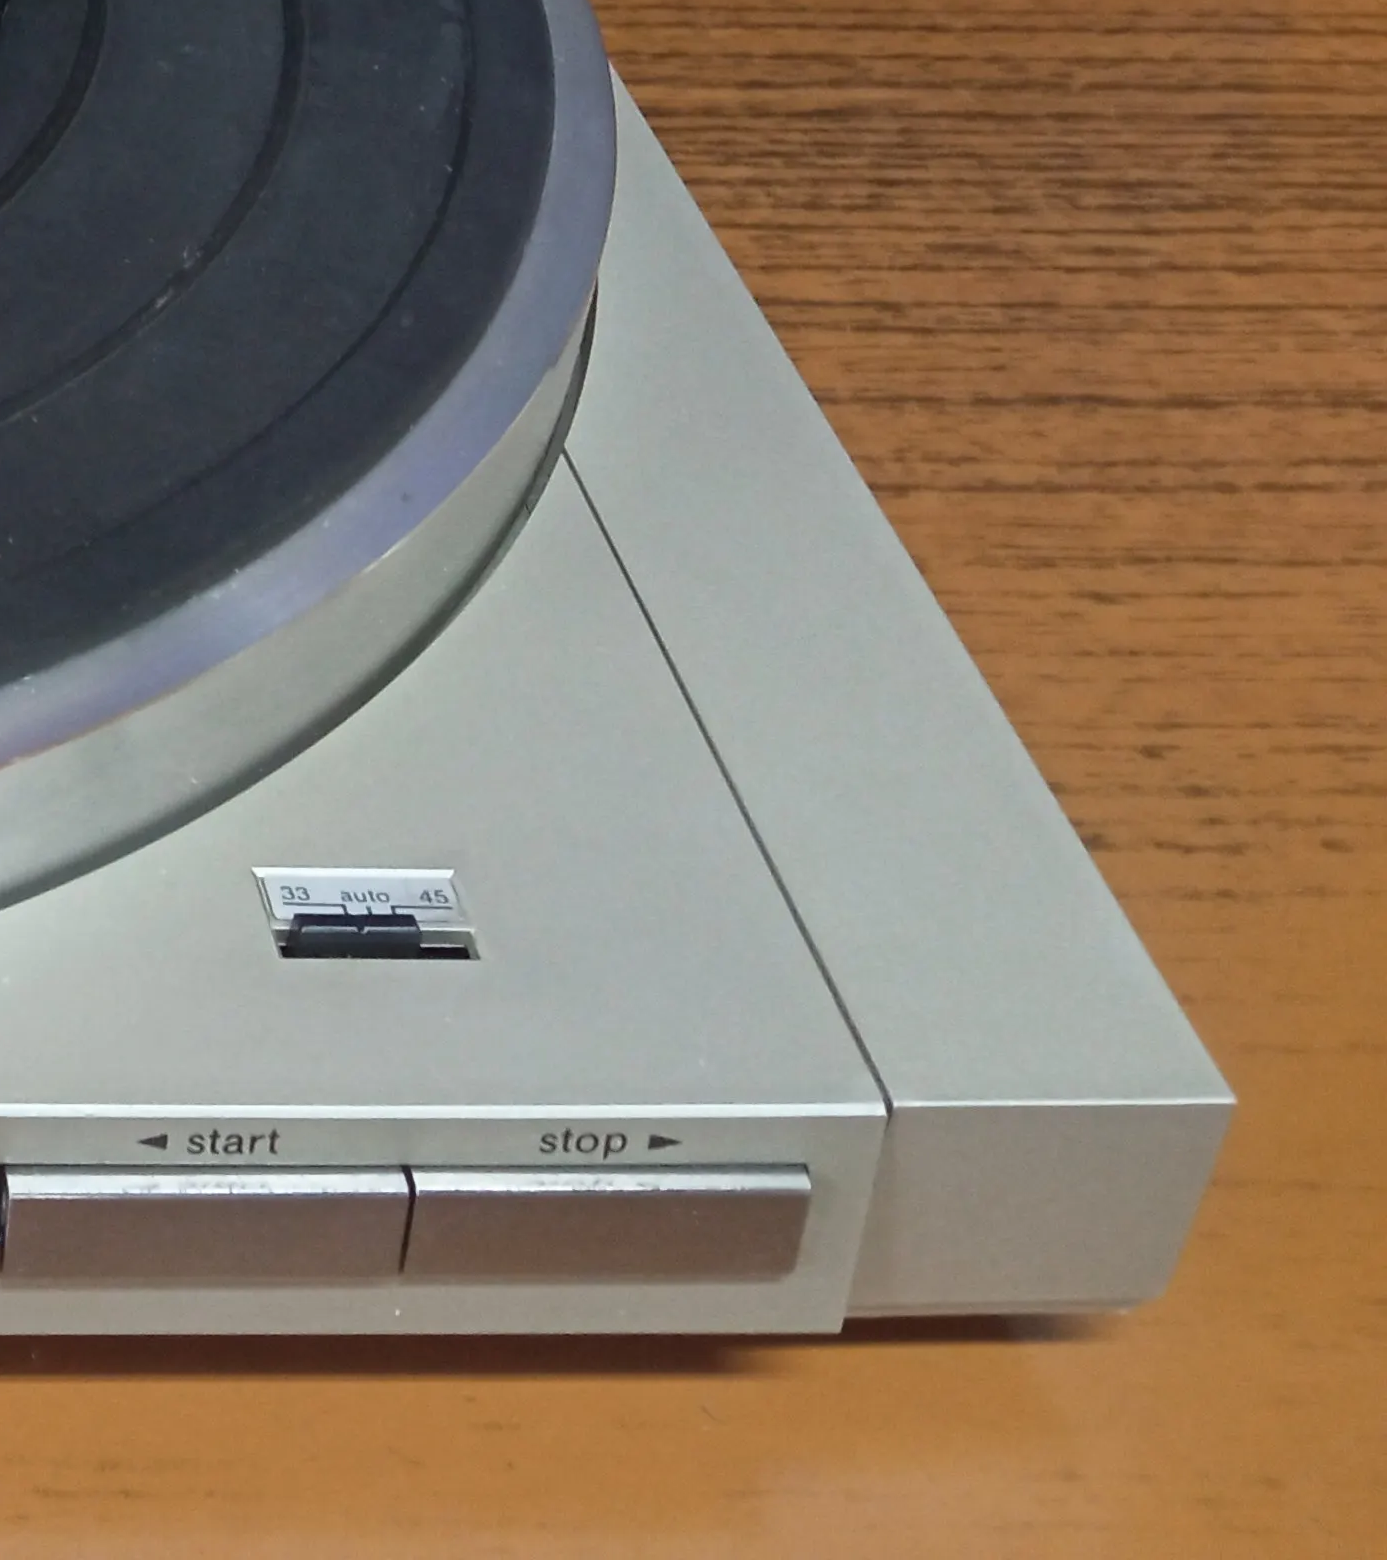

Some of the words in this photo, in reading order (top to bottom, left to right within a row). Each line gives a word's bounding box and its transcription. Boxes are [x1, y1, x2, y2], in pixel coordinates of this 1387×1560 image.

[280, 885, 310, 901] 33
[340, 888, 390, 903] auto
[419, 889, 449, 904] 45
[186, 1127, 280, 1155] start
[539, 1127, 628, 1159] stop
